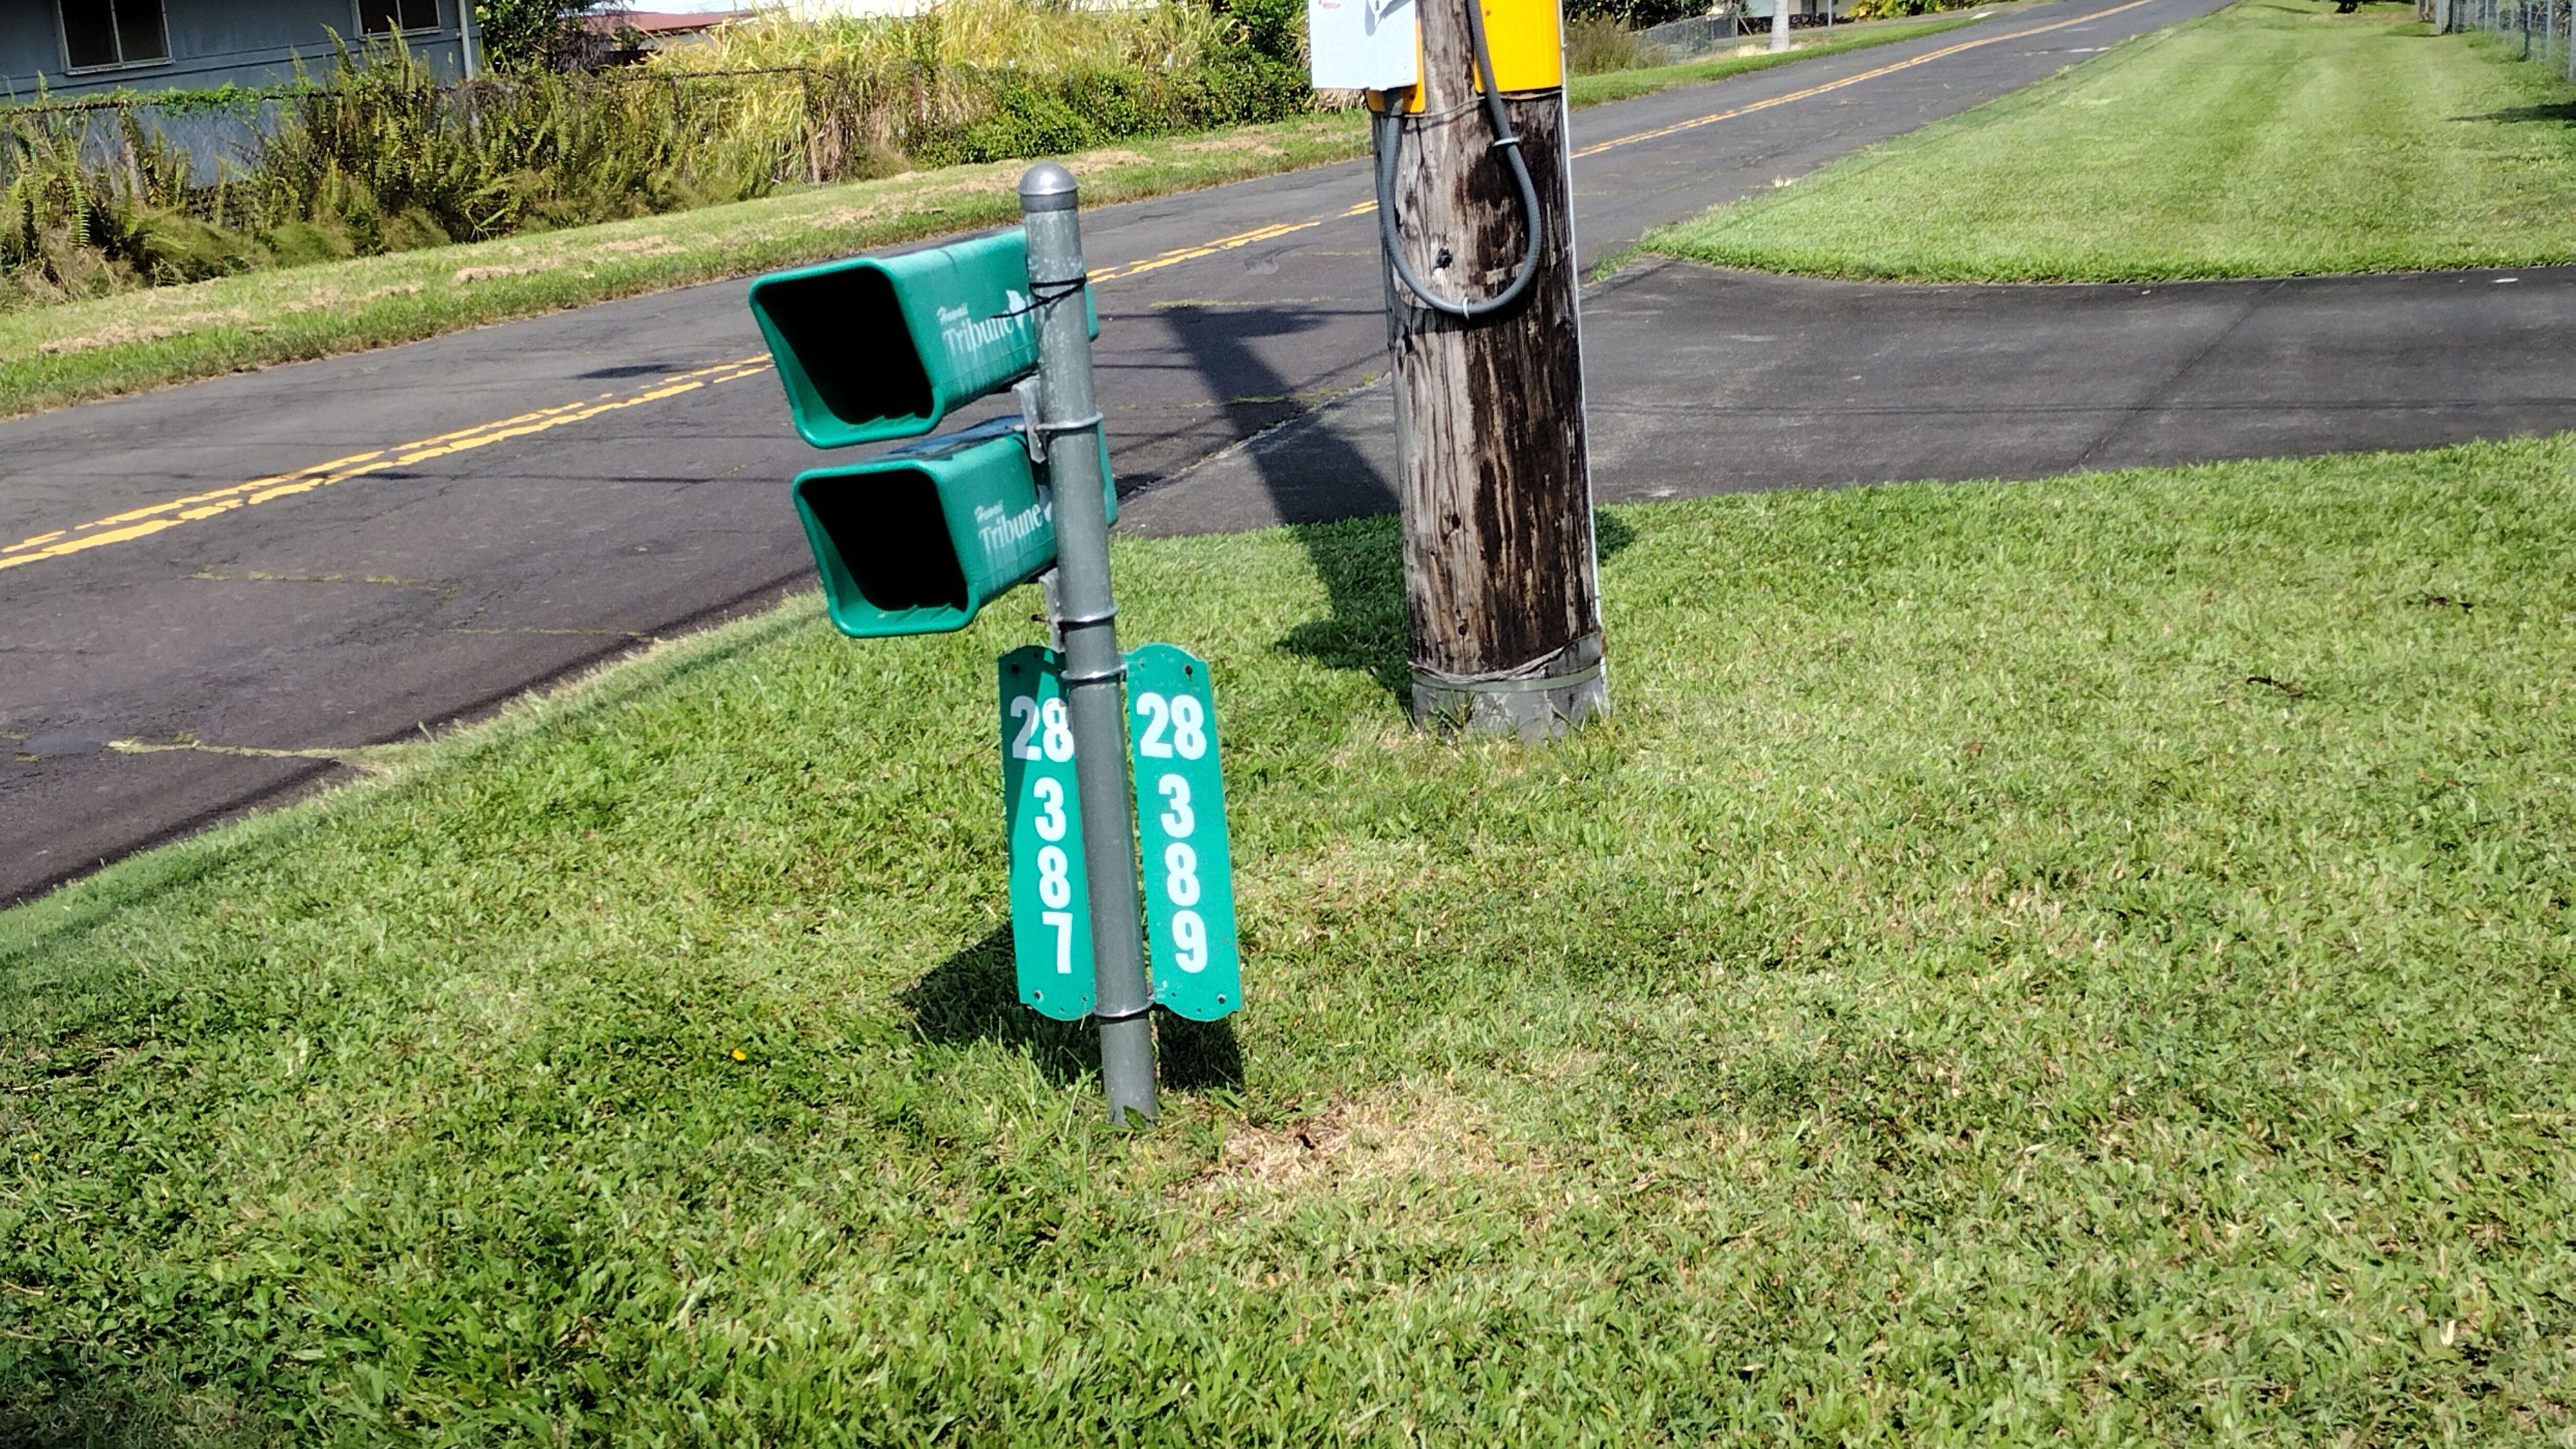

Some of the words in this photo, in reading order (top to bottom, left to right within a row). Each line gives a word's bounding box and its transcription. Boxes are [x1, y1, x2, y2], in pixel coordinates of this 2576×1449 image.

[942, 311, 1014, 354] Tribune
[978, 504, 1043, 555] Tribune
[1010, 696, 1074, 762] 28
[1137, 692, 1207, 760] 28
